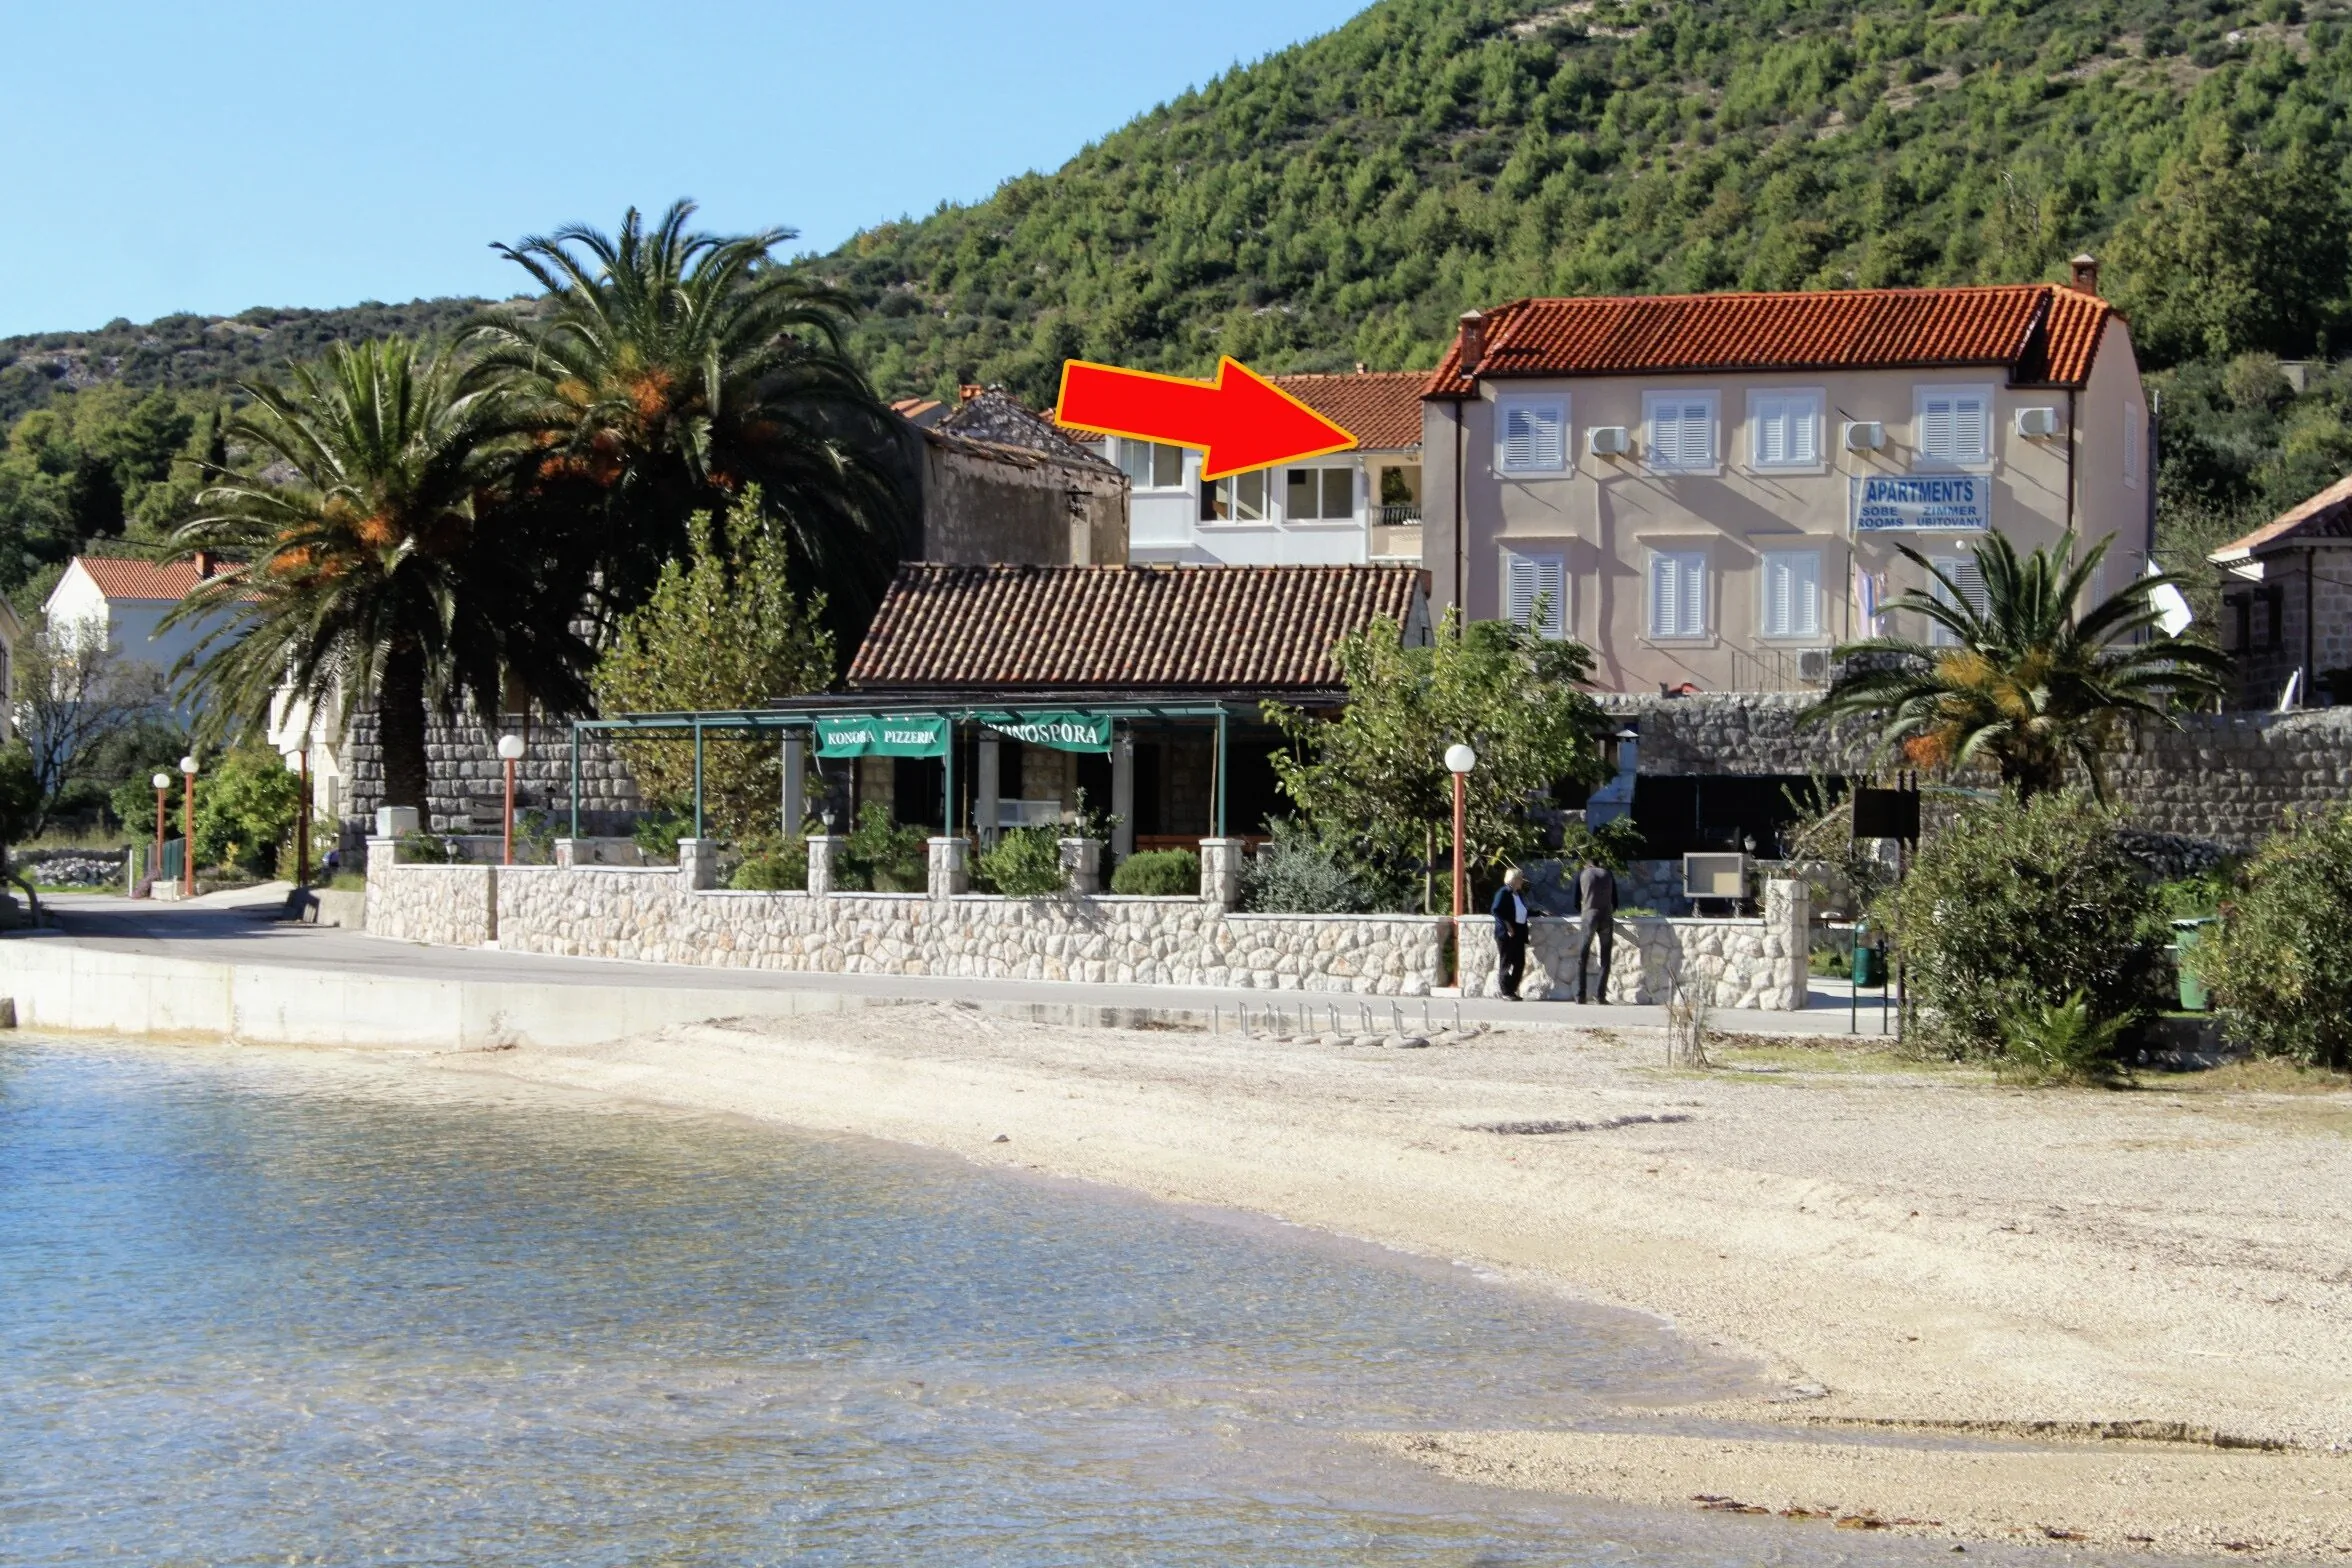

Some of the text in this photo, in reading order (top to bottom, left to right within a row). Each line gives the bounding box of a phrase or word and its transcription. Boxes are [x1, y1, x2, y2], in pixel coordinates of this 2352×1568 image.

[1866, 480, 1974, 503] APARTMENTS
[1862, 506, 1977, 516] SOBE ZIMMER
[1858, 517, 1904, 527] ROOMS
[827, 729, 937, 745] KONOBA PIZZERIA
